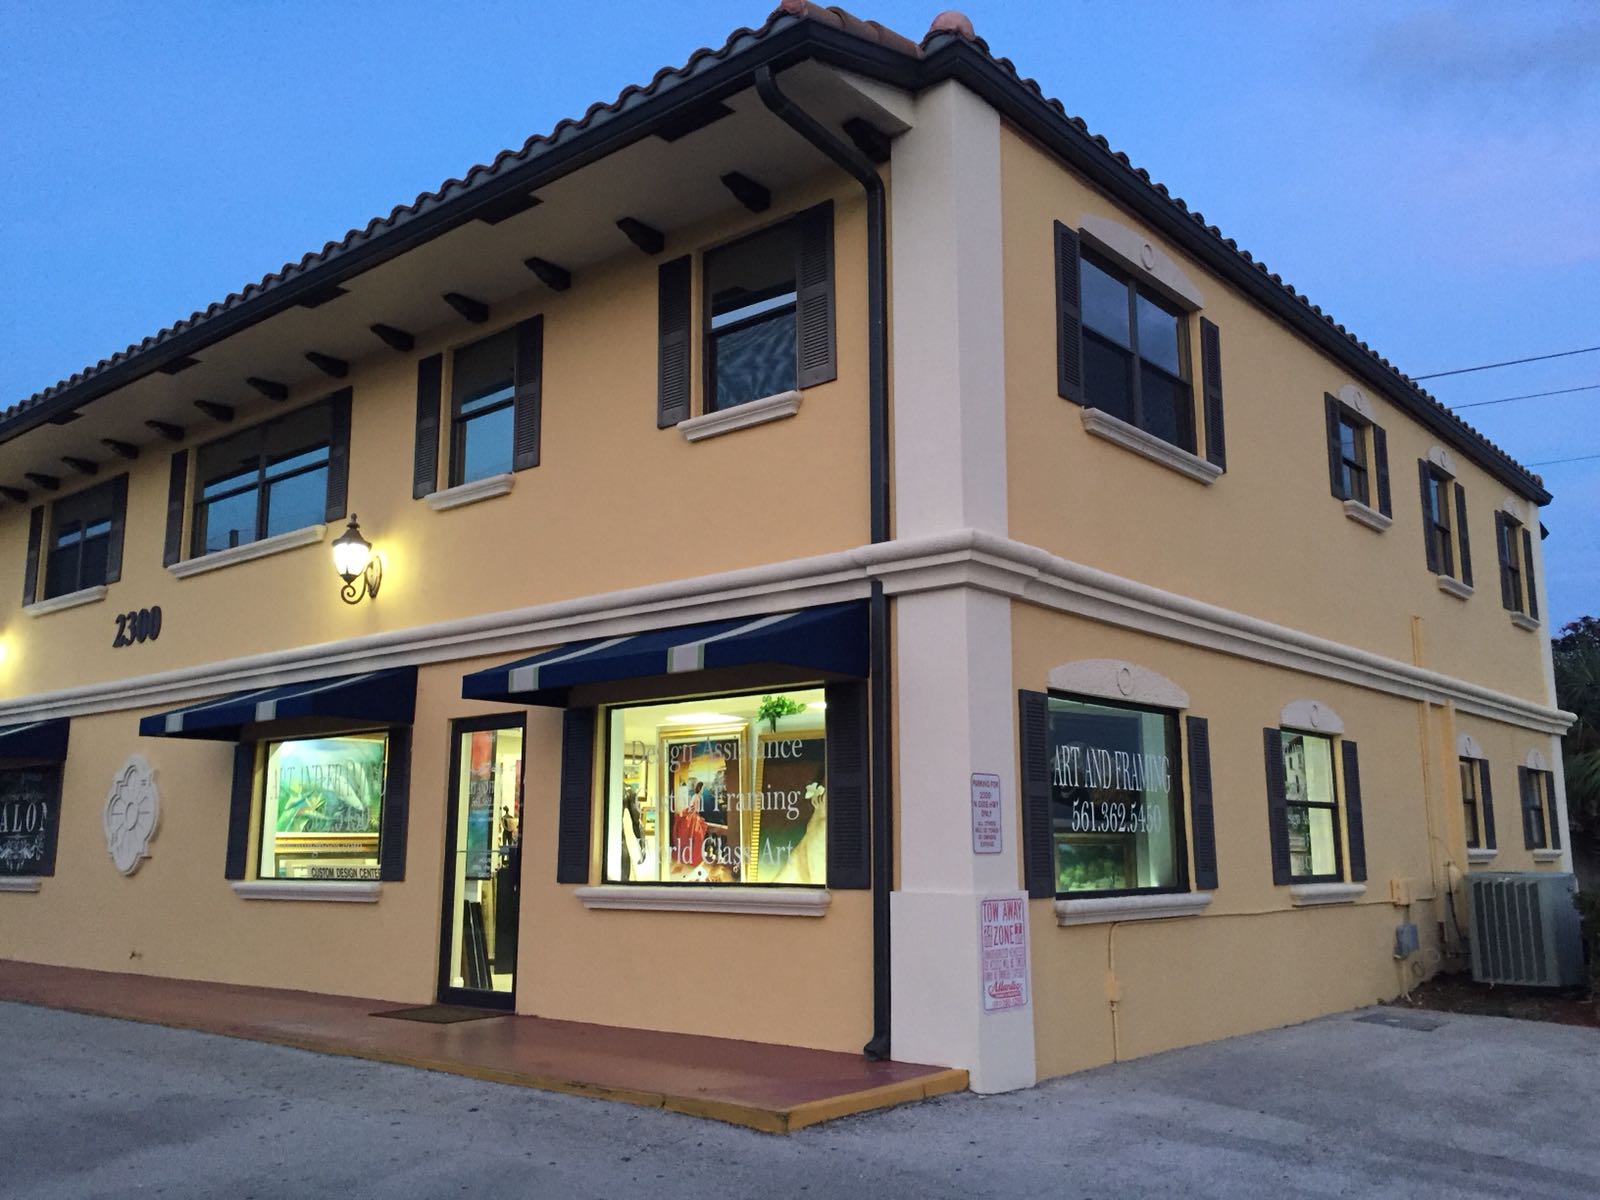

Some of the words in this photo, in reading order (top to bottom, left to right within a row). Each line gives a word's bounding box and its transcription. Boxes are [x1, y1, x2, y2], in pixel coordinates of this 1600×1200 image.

[112, 606, 162, 648] 2300
[631, 739, 698, 772] Degn
[702, 736, 803, 760] Assiance
[1053, 745, 1080, 787] ART
[1084, 747, 1112, 790] AND
[1114, 750, 1171, 794] FRAMING
[712, 784, 802, 820] Framing
[1071, 798, 1162, 833] 561.362.5450
[758, 836, 796, 866] Art
[311, 867, 334, 878] CUSTOM
[336, 867, 358, 878] DESIGN
[982, 902, 999, 923] TOW
[1003, 900, 1022, 922] AWAY
[993, 924, 1015, 946] ZONE
